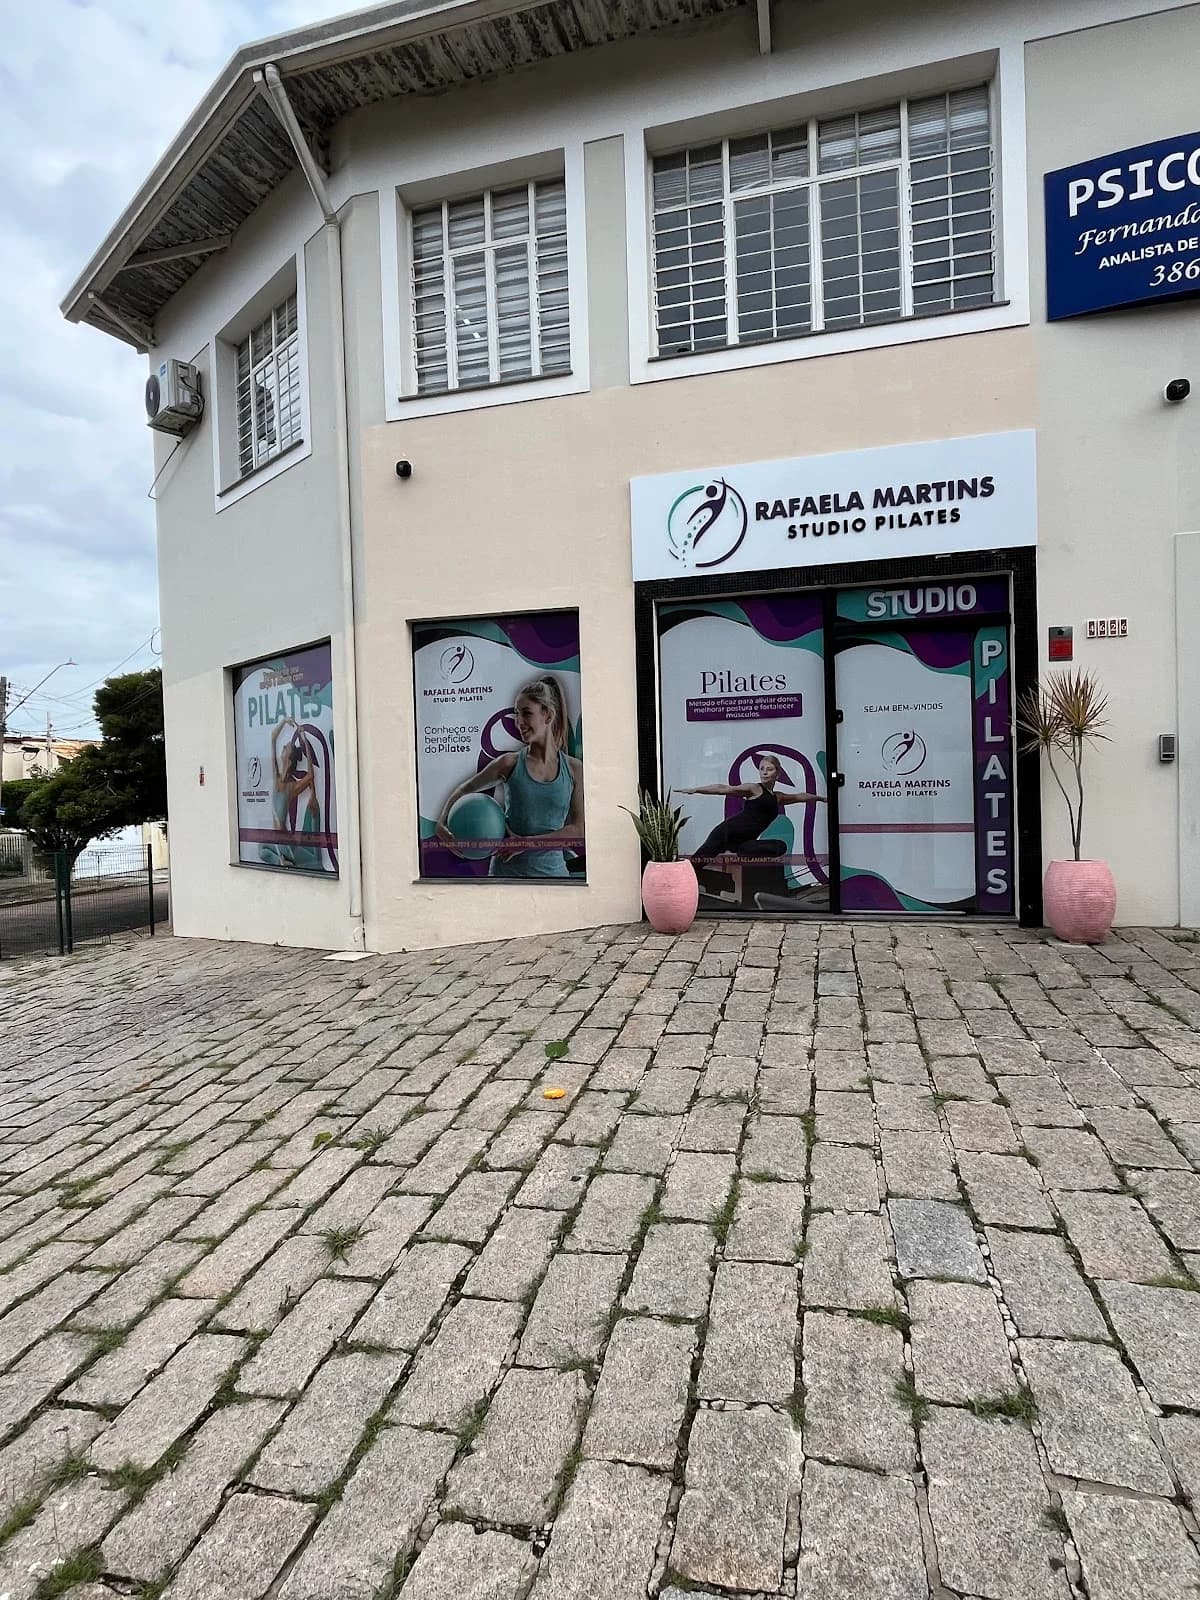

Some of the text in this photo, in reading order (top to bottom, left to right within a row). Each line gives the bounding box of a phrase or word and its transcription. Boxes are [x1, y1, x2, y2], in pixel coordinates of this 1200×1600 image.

[1099, 237, 1199, 269] ANALISTA DE
[1150, 258, 1200, 286] 386
[756, 476, 995, 520] RAFAELA MARTINS
[788, 508, 961, 539] STUDIO PILATES
[867, 585, 977, 617] STUDIO
[423, 686, 493, 696] RAFAELA MARTINS
[700, 670, 787, 694] Pilates
[247, 685, 322, 727] PILATES
[716, 698, 736, 706] eficaz
[738, 698, 753, 706] para
[754, 696, 776, 704] aliviar
[726, 705, 753, 713] postura
[760, 703, 794, 711] fortalecer
[863, 703, 943, 713] SEJAM BEM-VINDOS
[424, 725, 466, 735] Conheça
[424, 743, 471, 754] do Pilates
[980, 640, 1008, 894] PILATES
[858, 779, 951, 789] RAFAELA MARTINS
